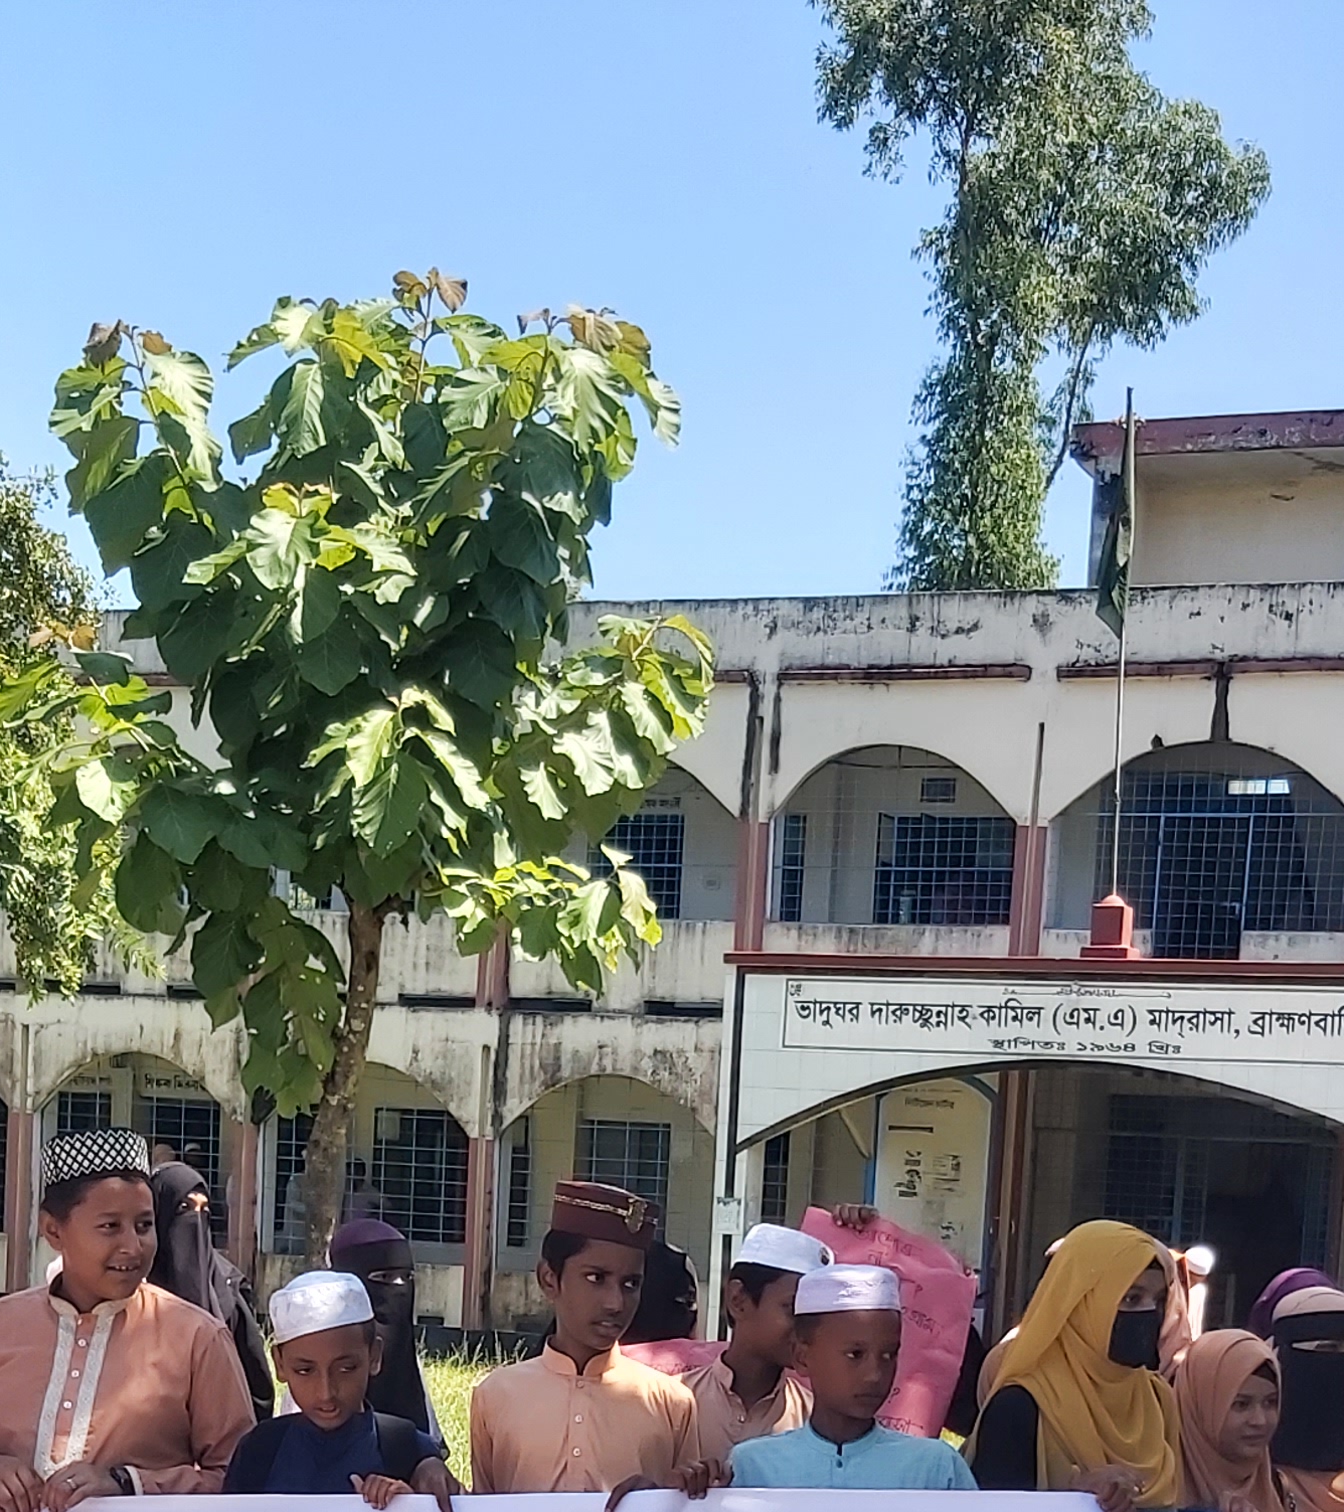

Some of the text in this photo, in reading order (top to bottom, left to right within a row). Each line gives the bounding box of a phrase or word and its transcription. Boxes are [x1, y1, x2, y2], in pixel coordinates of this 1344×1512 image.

[794, 1000, 862, 1029] ভাদুঘর
[977, 998, 1044, 1029] কামিল
[1052, 1003, 1137, 1037] (এম.এ)
